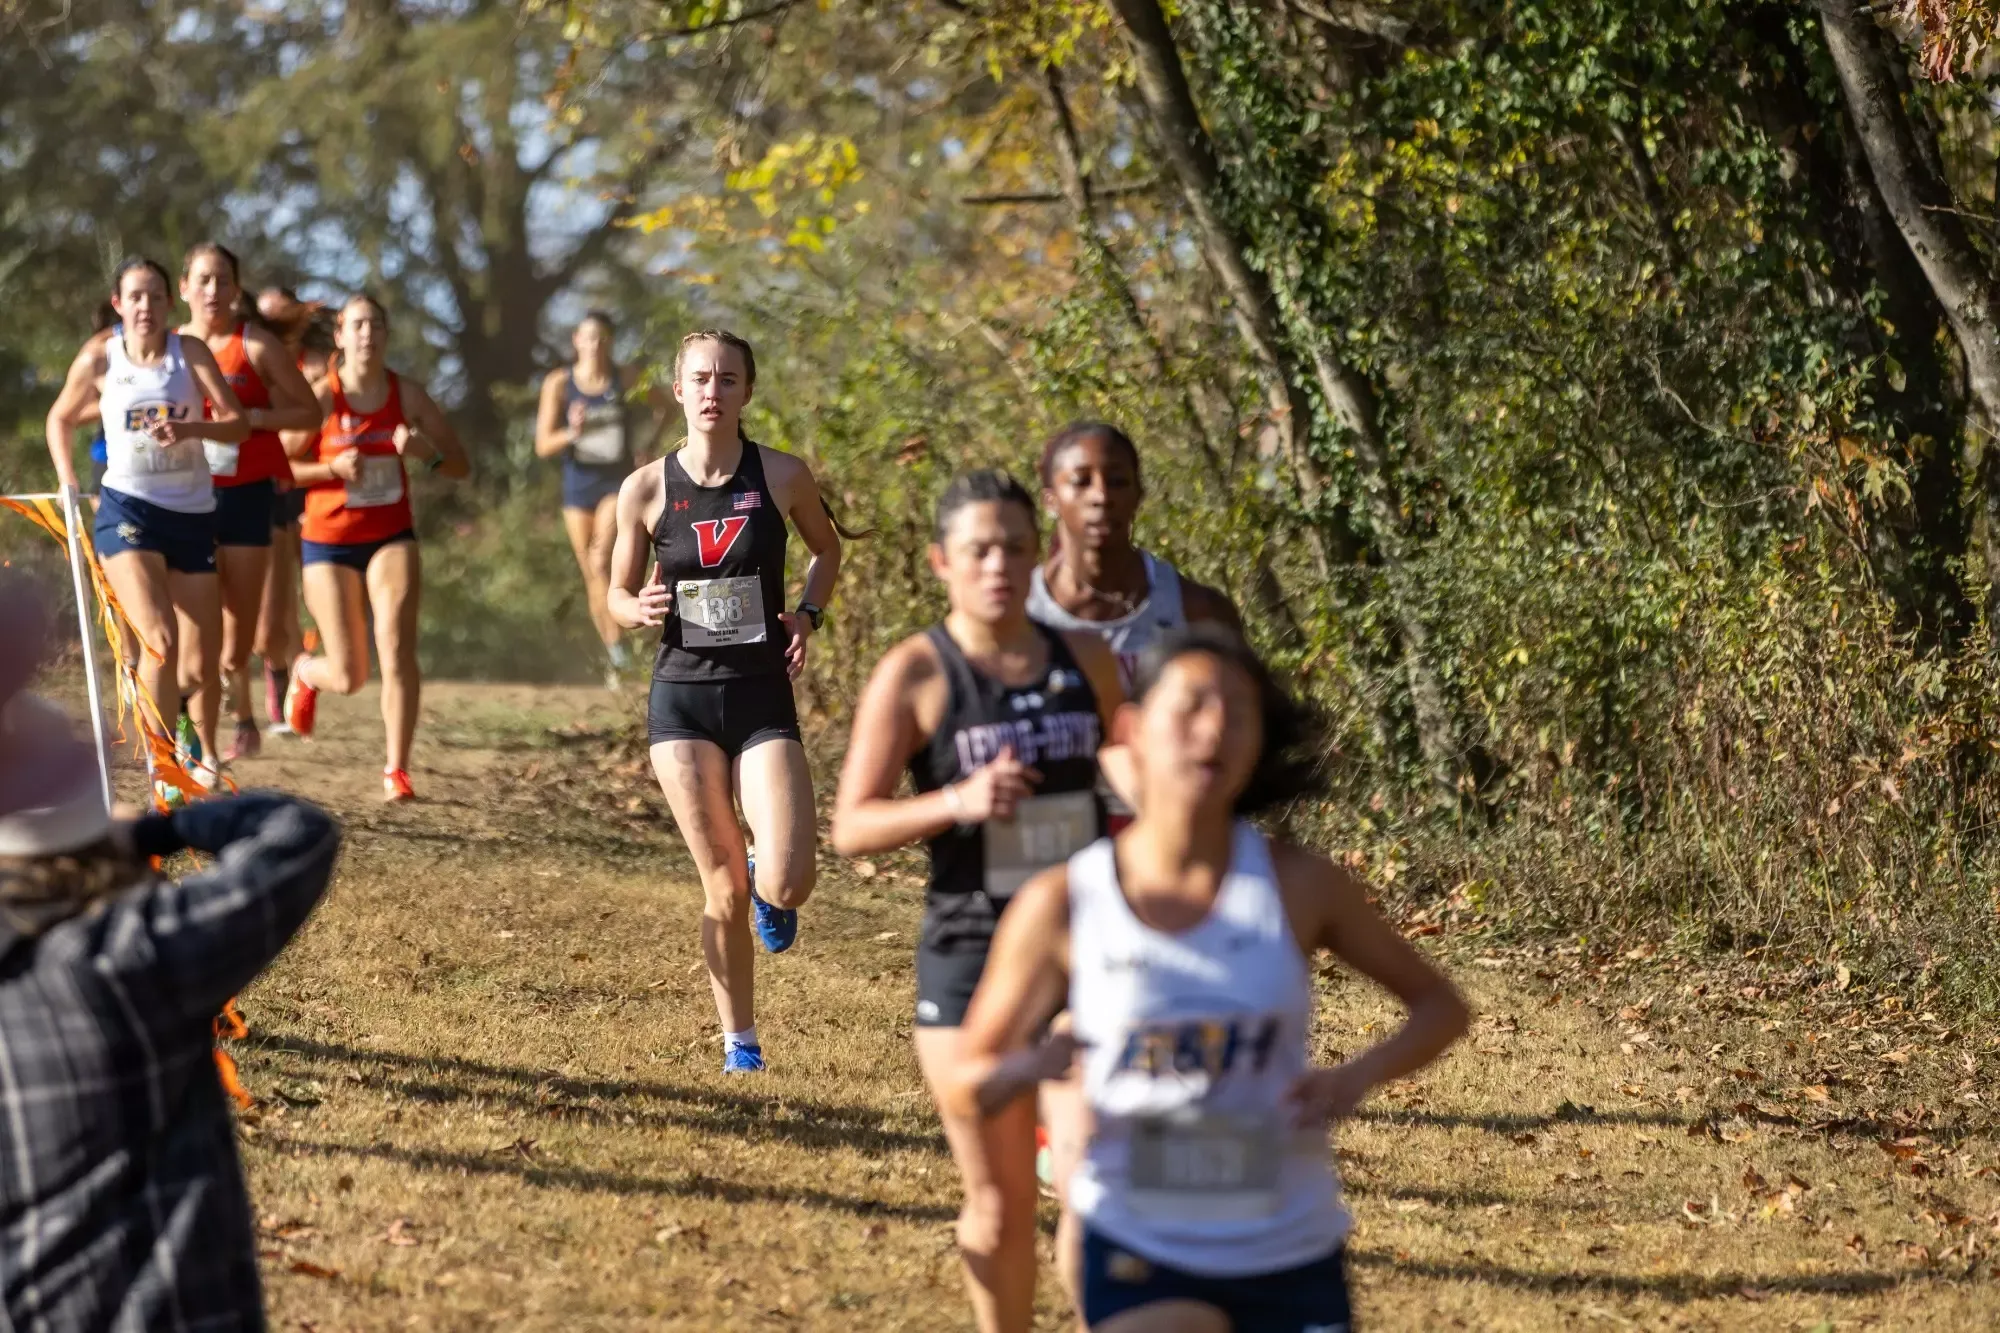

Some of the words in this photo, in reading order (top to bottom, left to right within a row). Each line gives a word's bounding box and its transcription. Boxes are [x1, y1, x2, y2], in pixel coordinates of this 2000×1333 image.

[691, 515, 749, 568] V
[734, 581, 753, 590] SAC
[697, 596, 743, 624] 138
